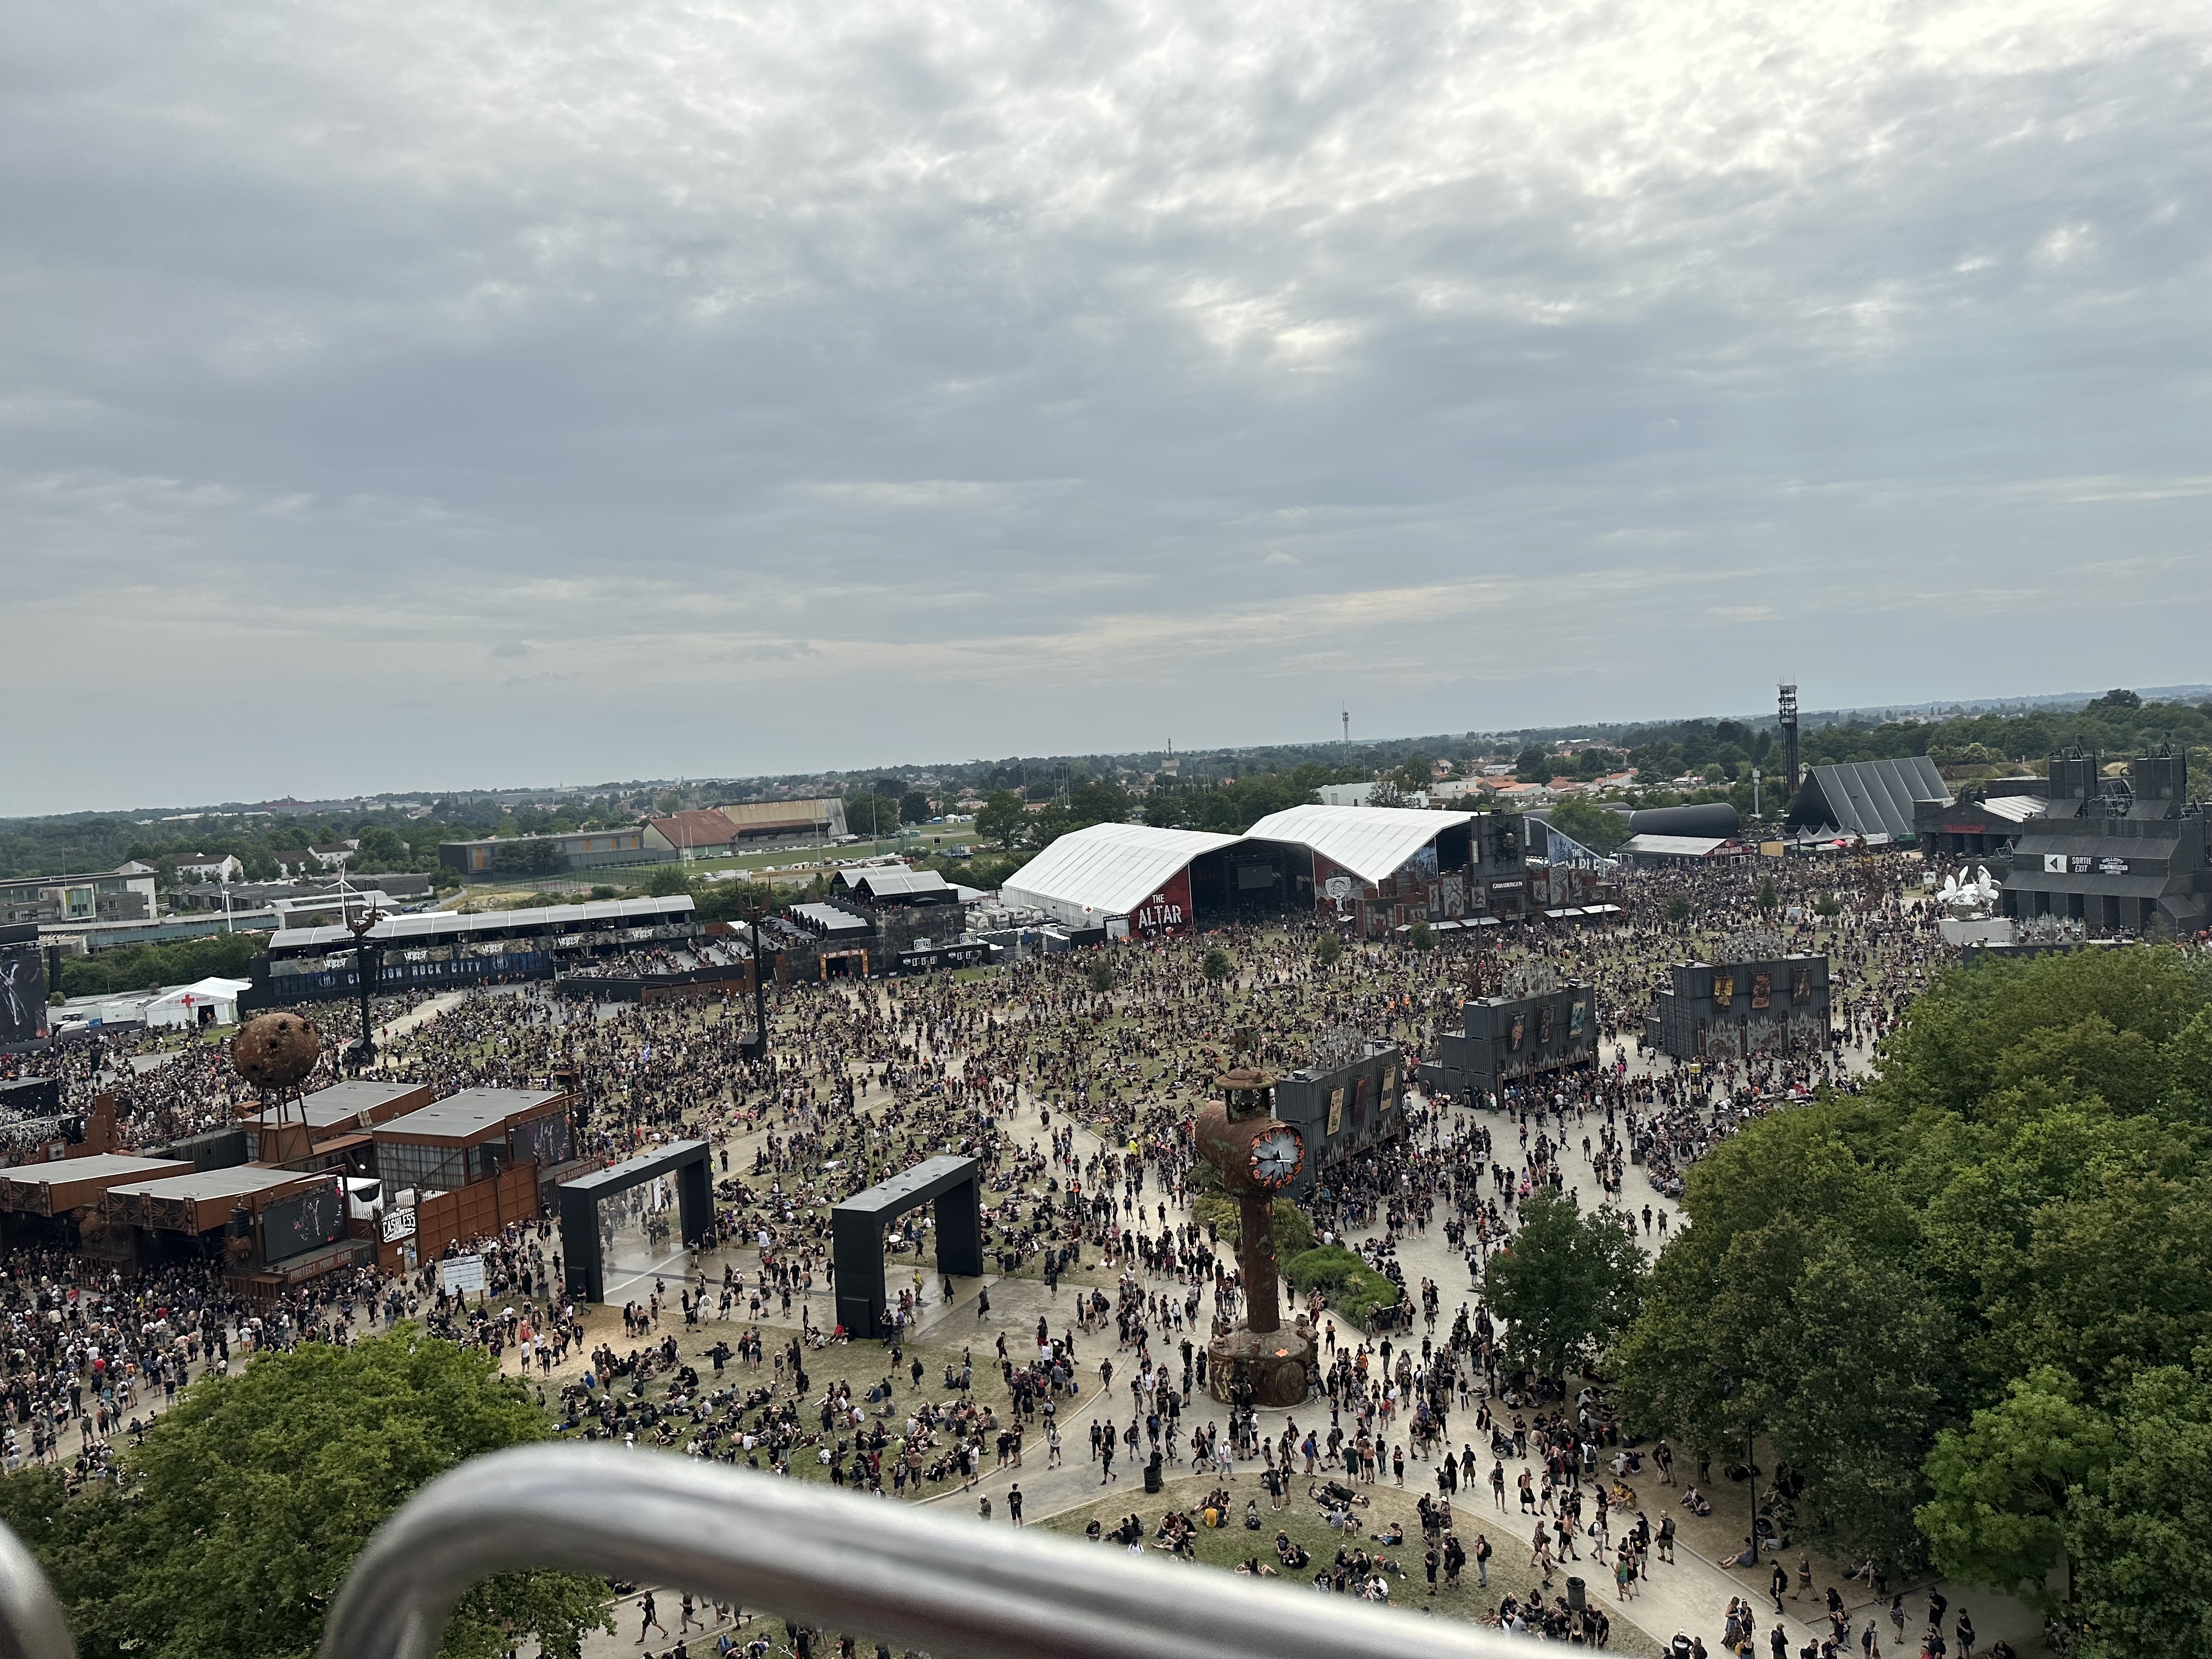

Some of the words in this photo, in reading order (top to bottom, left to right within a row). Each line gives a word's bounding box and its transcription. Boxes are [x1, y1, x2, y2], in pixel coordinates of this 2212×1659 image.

[1571, 849, 1582, 857] THE
[1493, 881, 1522, 889] GRIMBERGEN
[1152, 894, 1165, 904] THE
[1138, 905, 1182, 929] ALTAR
[632, 928, 654, 941] HELLFEST
[558, 936, 581, 947] HELLFEST
[481, 943, 505, 954] HELLFEST
[404, 950, 428, 962] HELLFEST
[412, 963, 441, 976] ROCK
[452, 962, 481, 973] CITY
[555, 1173, 566, 1183] INFO
[568, 1164, 590, 1179] CASHLESS
[383, 1212, 416, 1238] CASHLESS
[290, 1263, 316, 1280] PROTECT
[319, 1257, 334, 1269] YOUR
[337, 1250, 351, 1263] EARS
